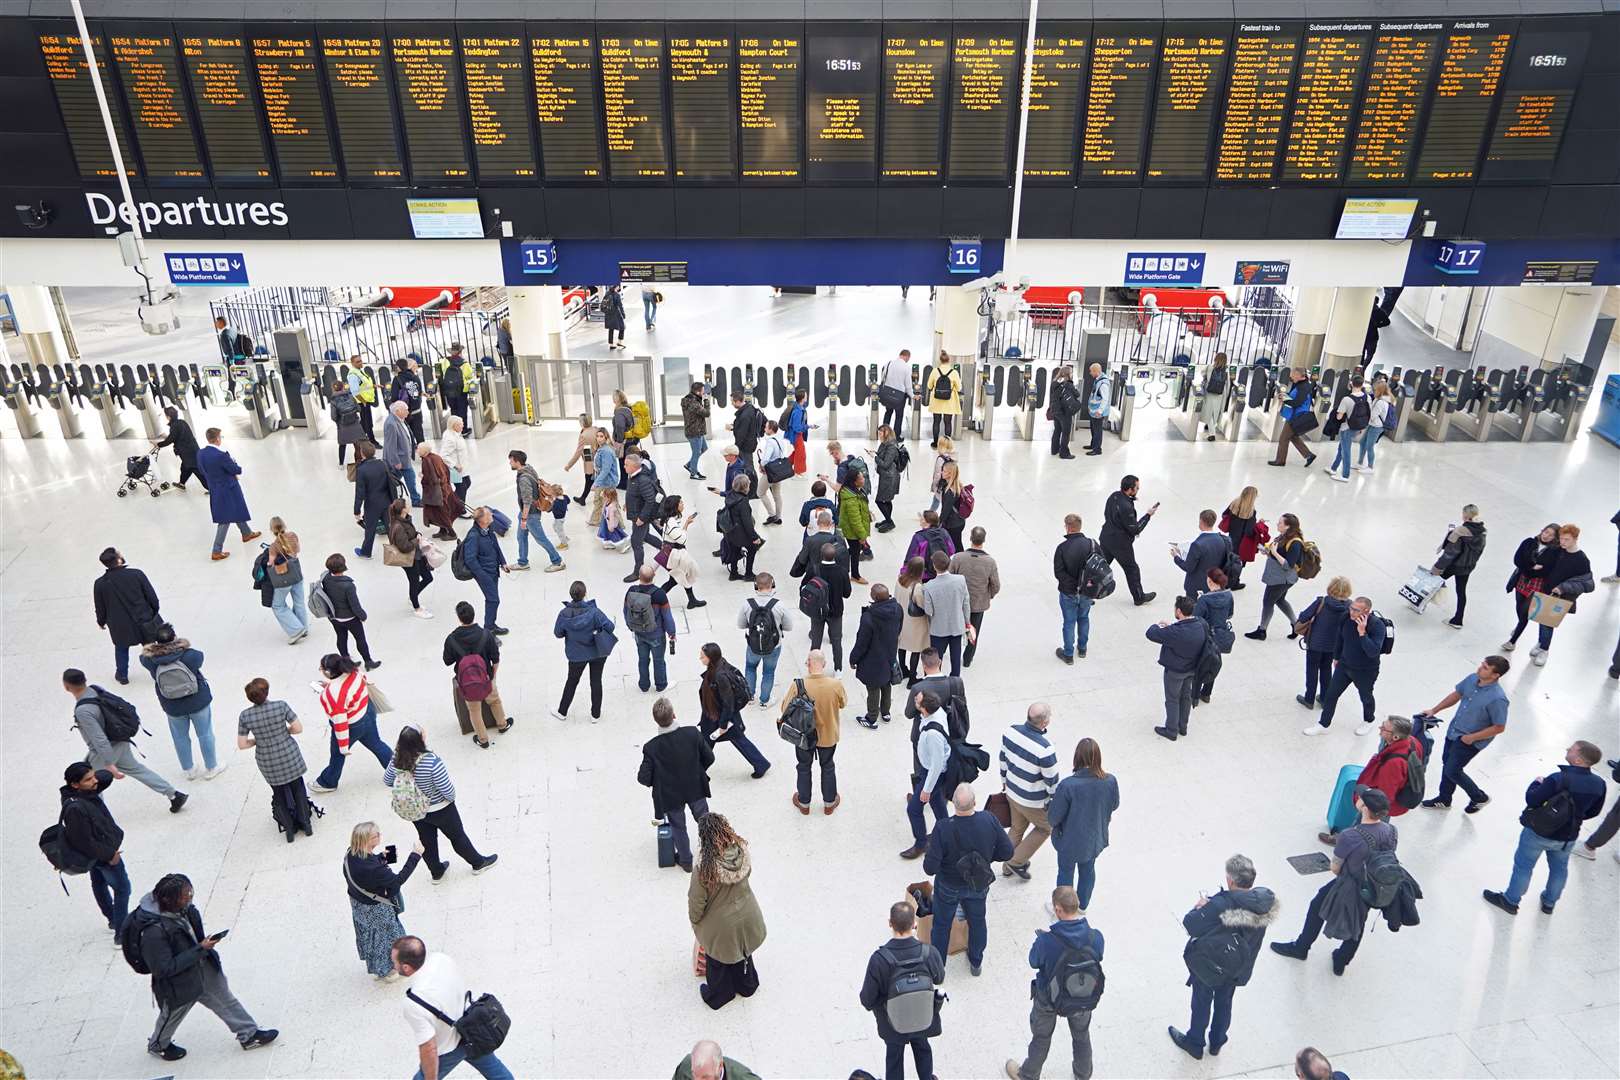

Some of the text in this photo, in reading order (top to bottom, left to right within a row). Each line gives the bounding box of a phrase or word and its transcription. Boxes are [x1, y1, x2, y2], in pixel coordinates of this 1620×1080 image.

[135, 38, 161, 46] Platform
[1166, 38, 1184, 46] 17:15
[1210, 38, 1224, 46] time
[85, 192, 288, 232] Departures
[526, 250, 548, 265] 15
[956, 249, 977, 264] 16
[1439, 246, 1453, 263] 17
[1456, 250, 1480, 265] 17
